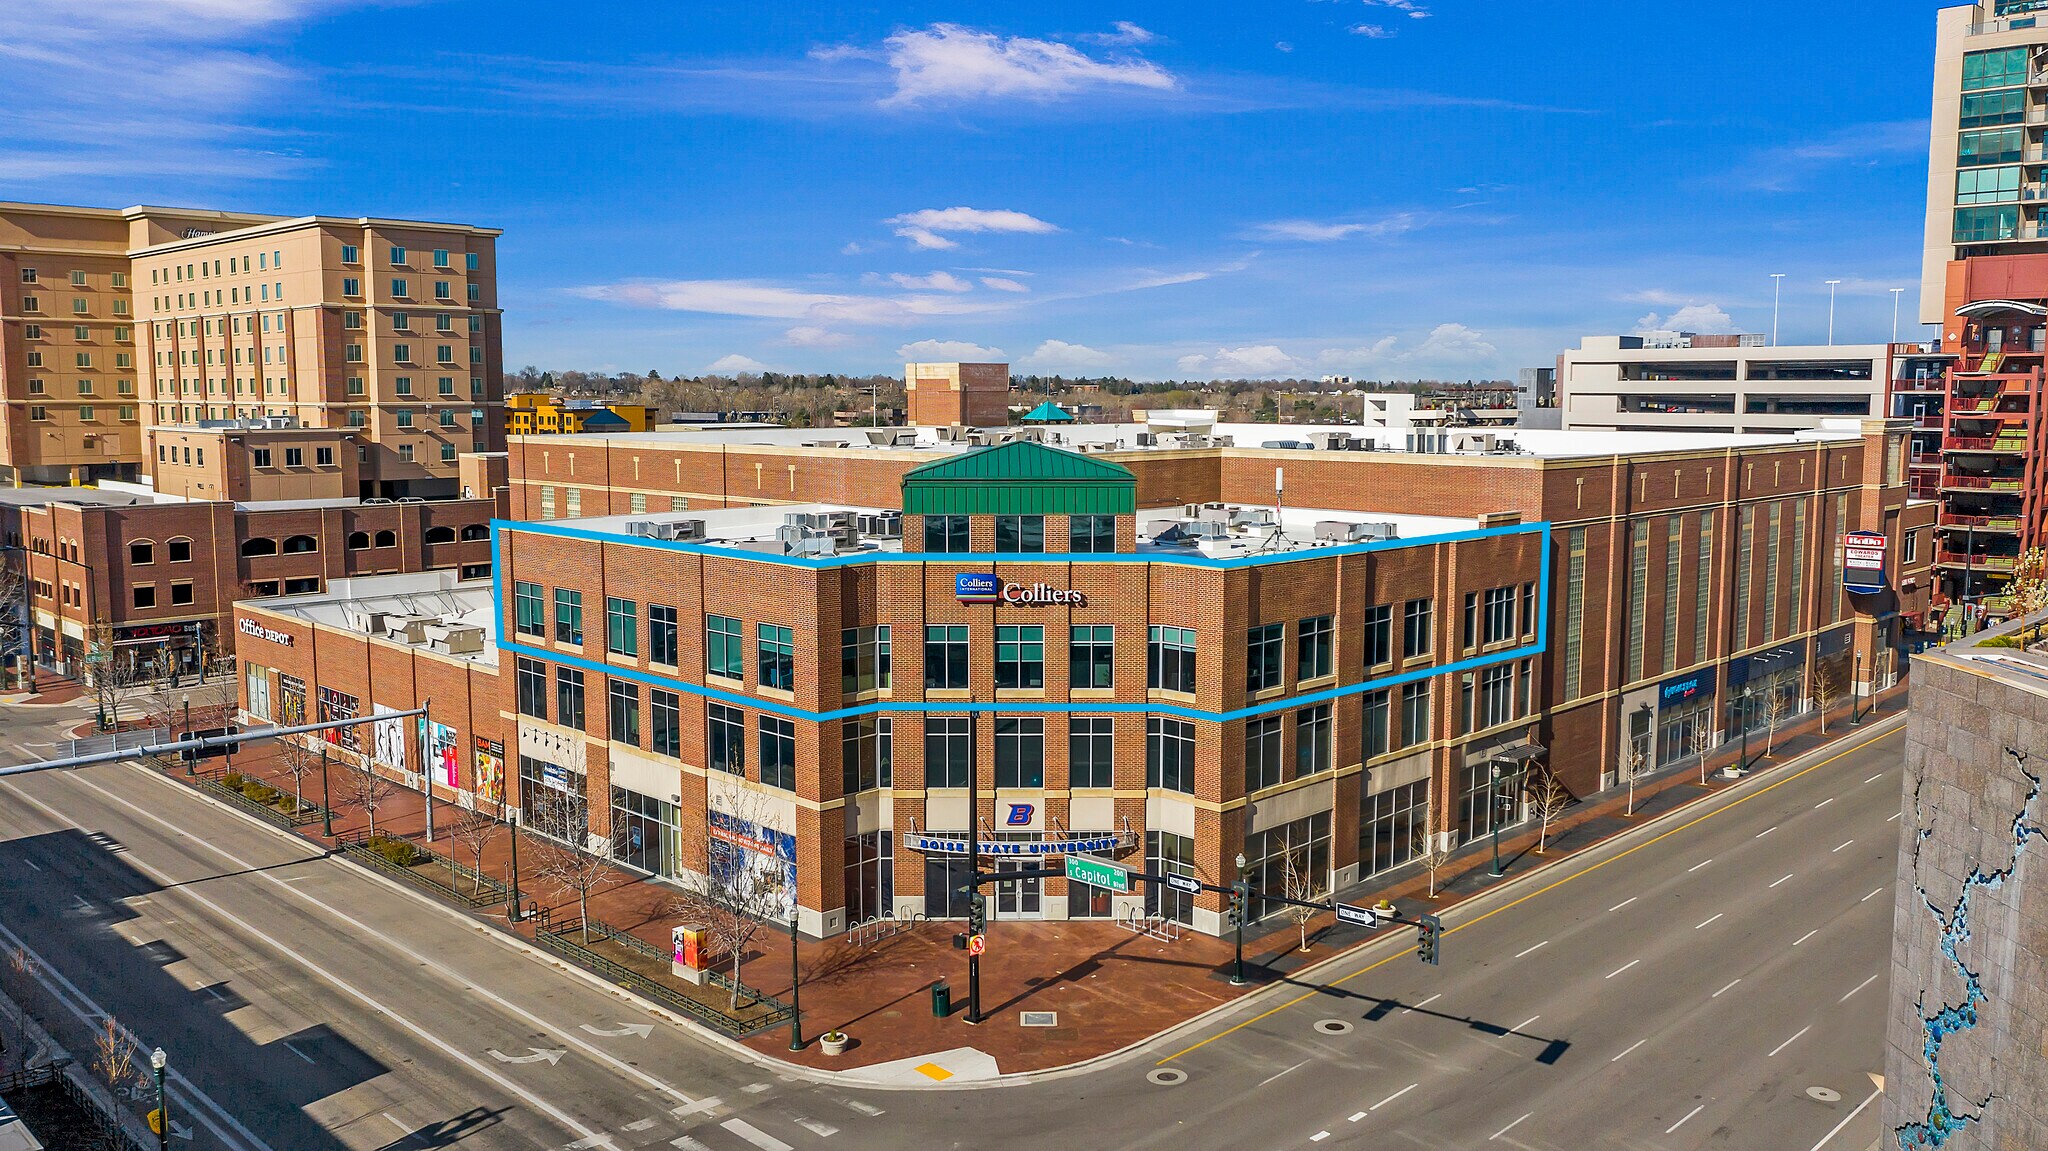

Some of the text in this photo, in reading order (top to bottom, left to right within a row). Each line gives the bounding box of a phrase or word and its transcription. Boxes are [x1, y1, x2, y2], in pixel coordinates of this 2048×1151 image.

[960, 578, 993, 588] Colliers
[1003, 582, 1082, 602] Colliers
[239, 618, 290, 645] Office DEPOT
[1006, 803, 1035, 825] B
[920, 839, 965, 853] BOISE
[1029, 837, 1119, 854] UNIVERSITY
[1069, 857, 1079, 866] 300
[1075, 866, 1110, 886] Capitol
[1112, 880, 1125, 889] Blvd
[1113, 869, 1124, 877] 200
[1340, 909, 1351, 917] ONE
